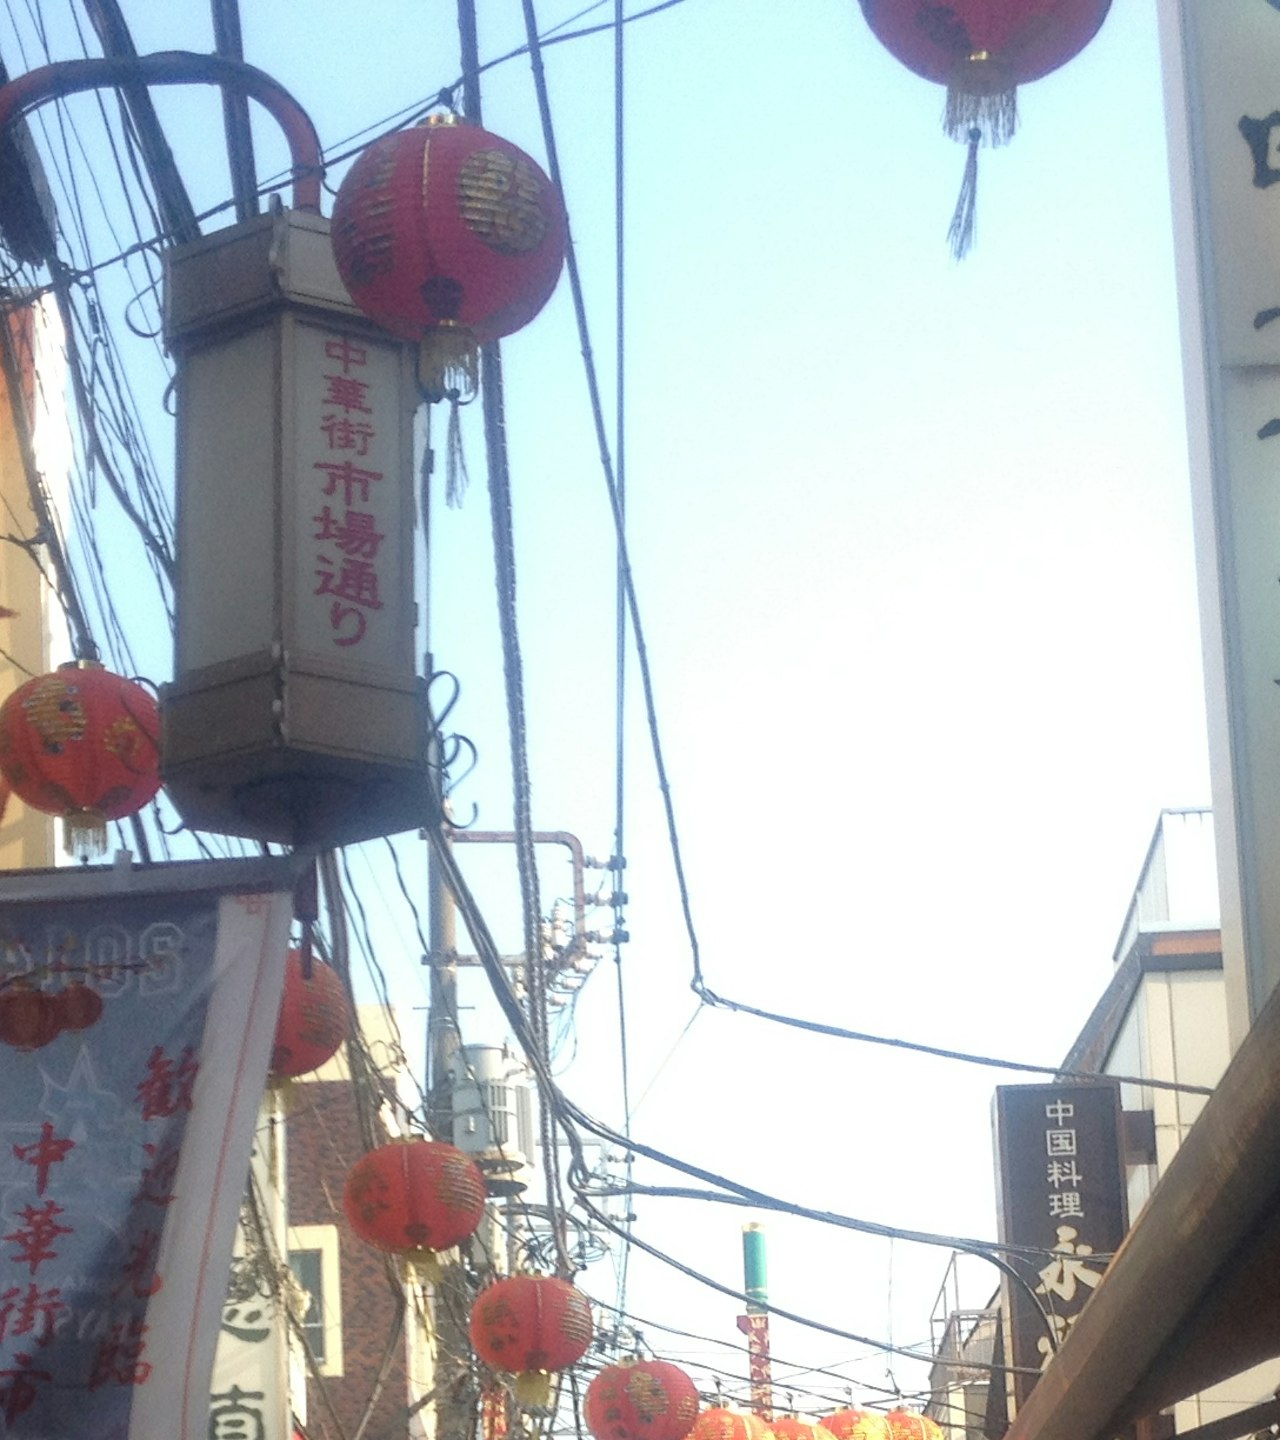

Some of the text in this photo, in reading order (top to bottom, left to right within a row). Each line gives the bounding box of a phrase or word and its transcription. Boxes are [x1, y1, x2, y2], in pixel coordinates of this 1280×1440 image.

[312, 338, 385, 648] 中華街市場通り
[1045, 1098, 1084, 1219] 中国料理
